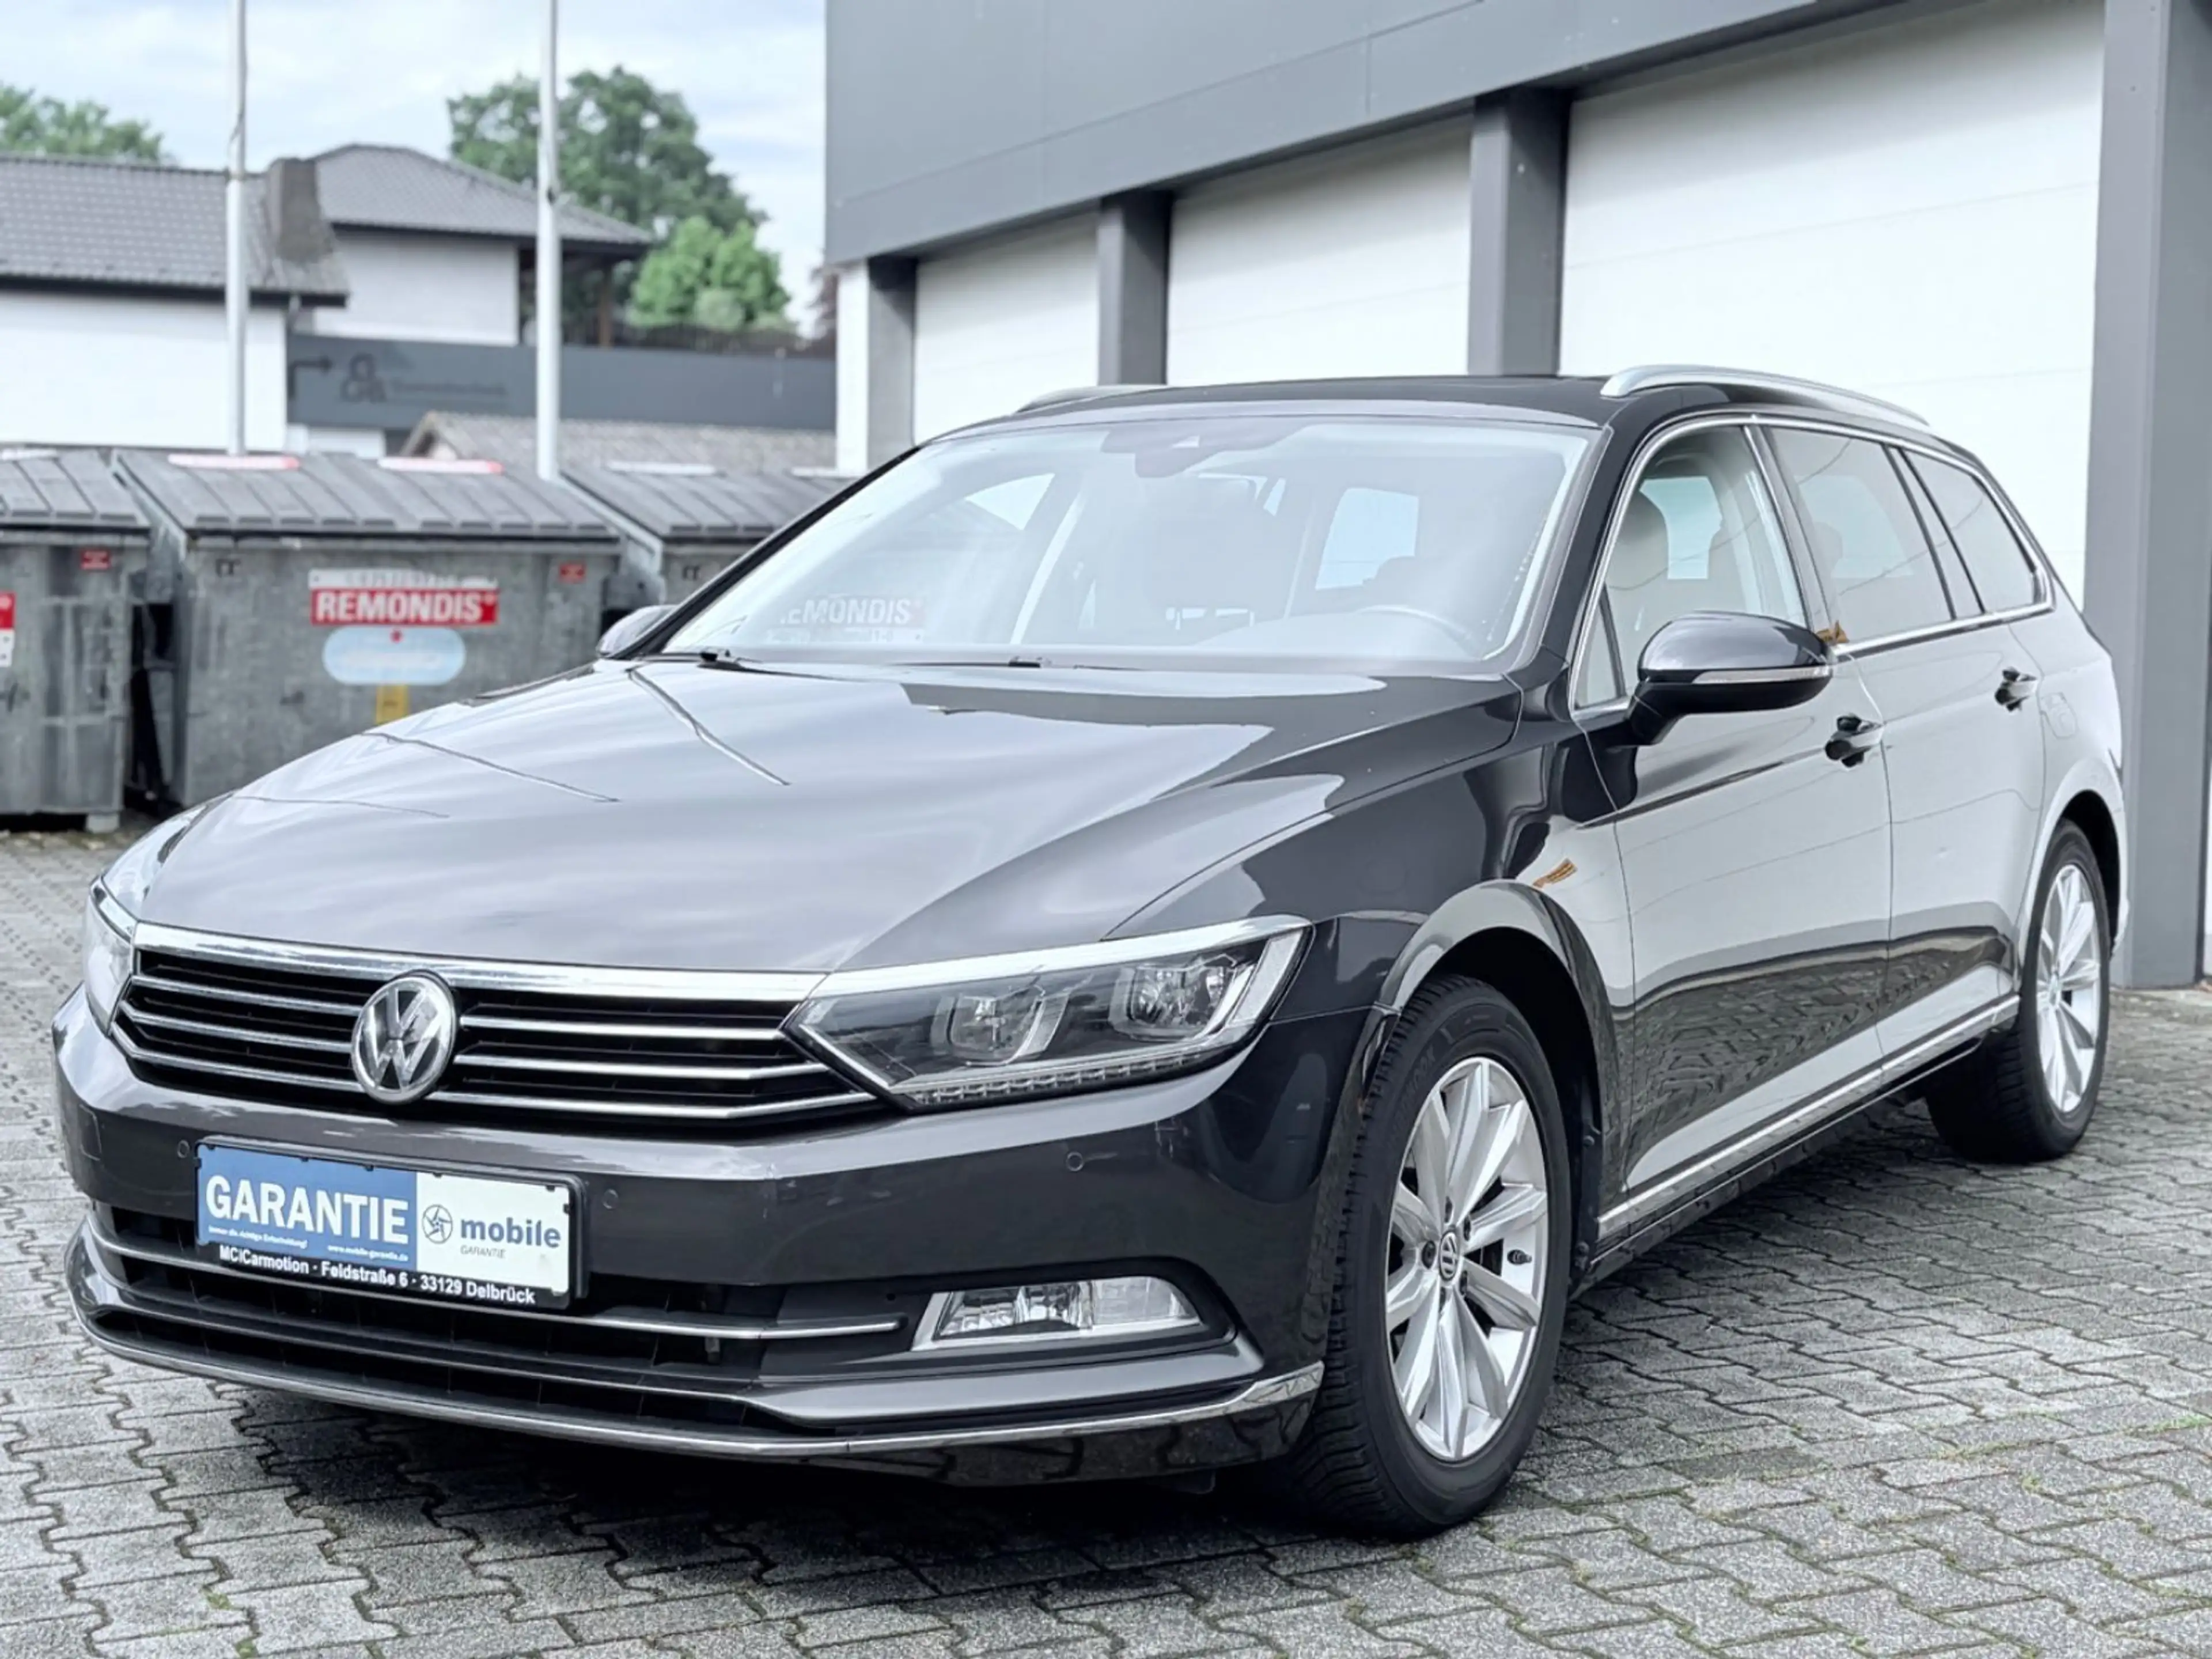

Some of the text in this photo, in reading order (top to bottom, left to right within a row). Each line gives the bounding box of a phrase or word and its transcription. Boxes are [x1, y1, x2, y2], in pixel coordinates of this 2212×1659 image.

[316, 590, 483, 623] REMONDIS
[206, 1175, 410, 1245] GARANTIE
[460, 1217, 562, 1249] mobile
[460, 1244, 506, 1259] GARANTIE
[321, 1260, 396, 1286] Feldstraße
[399, 1271, 408, 1288] 6
[420, 1274, 463, 1296] 33129
[465, 1281, 536, 1304] Delbrück
